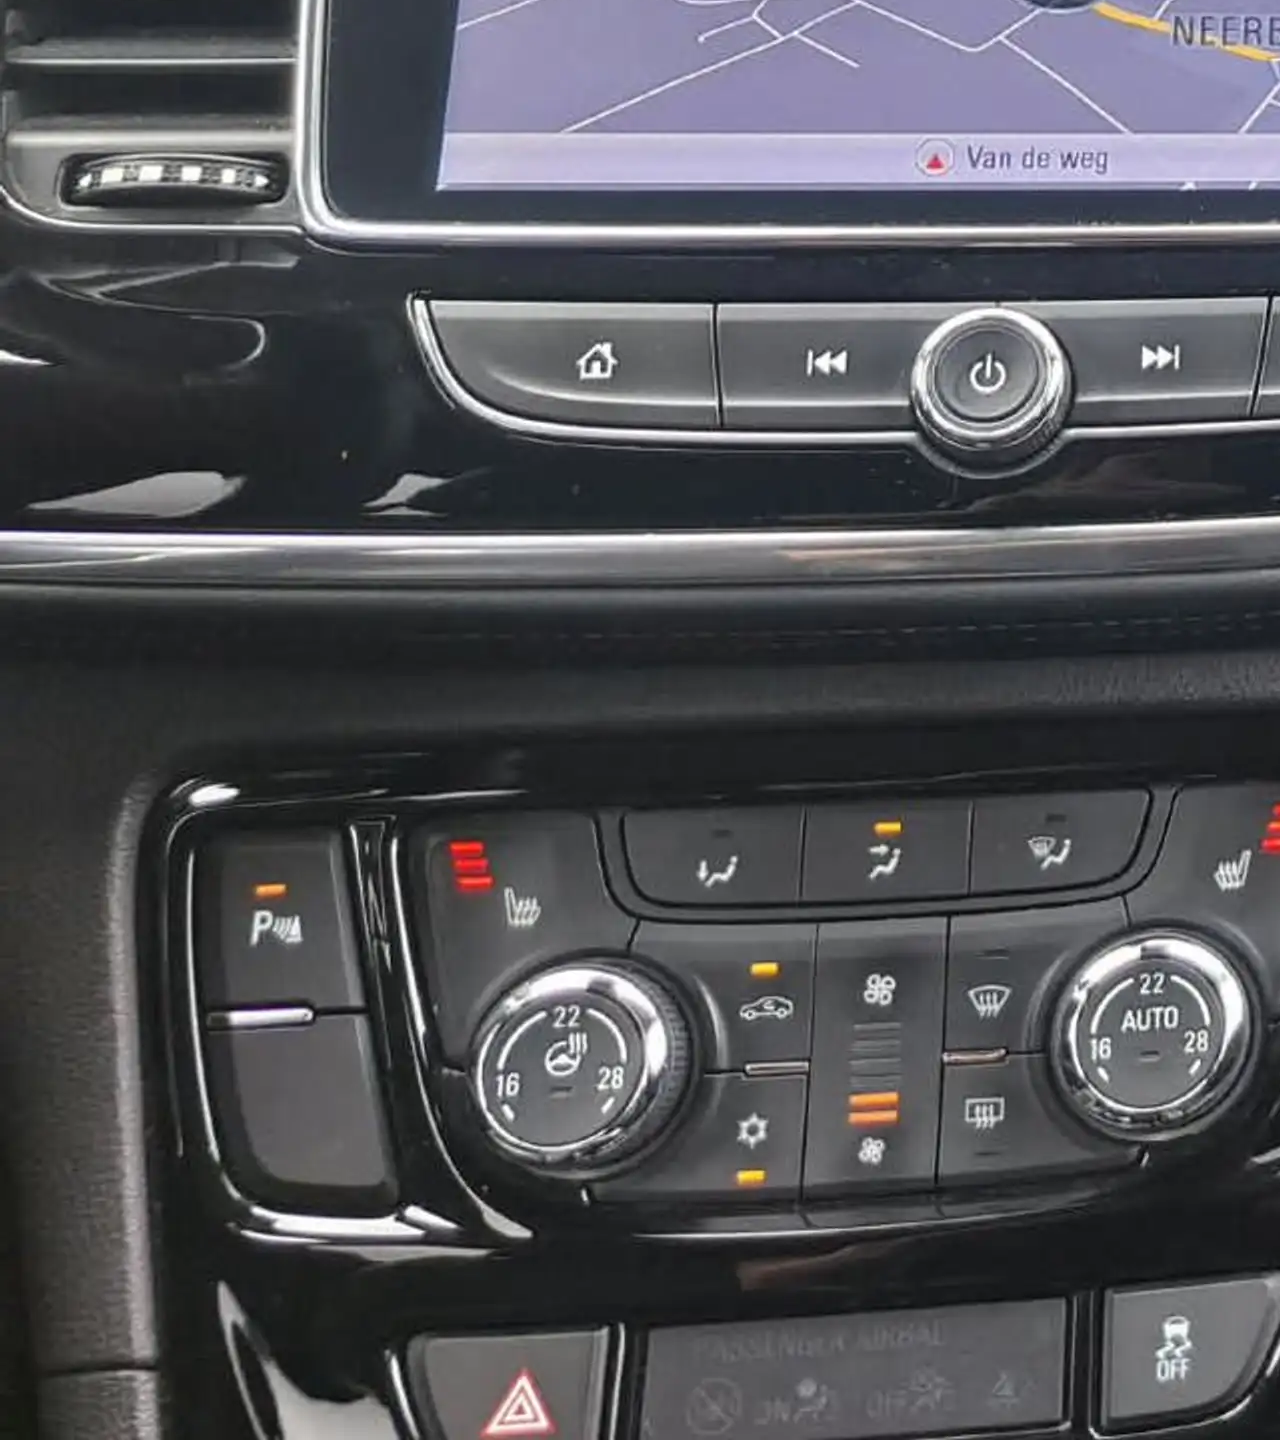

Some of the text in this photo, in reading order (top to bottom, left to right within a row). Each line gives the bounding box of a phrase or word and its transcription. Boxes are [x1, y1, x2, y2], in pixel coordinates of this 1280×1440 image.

[966, 144, 1110, 176] Van de weg
[1139, 972, 1165, 995] 22
[552, 1004, 581, 1028] 22
[1120, 1005, 1179, 1033] AUTO
[1090, 1037, 1112, 1063] 16
[1183, 1029, 1209, 1054] 28
[496, 1072, 520, 1098] 16
[597, 1066, 625, 1091] 28
[1156, 1357, 1192, 1383] OFF
